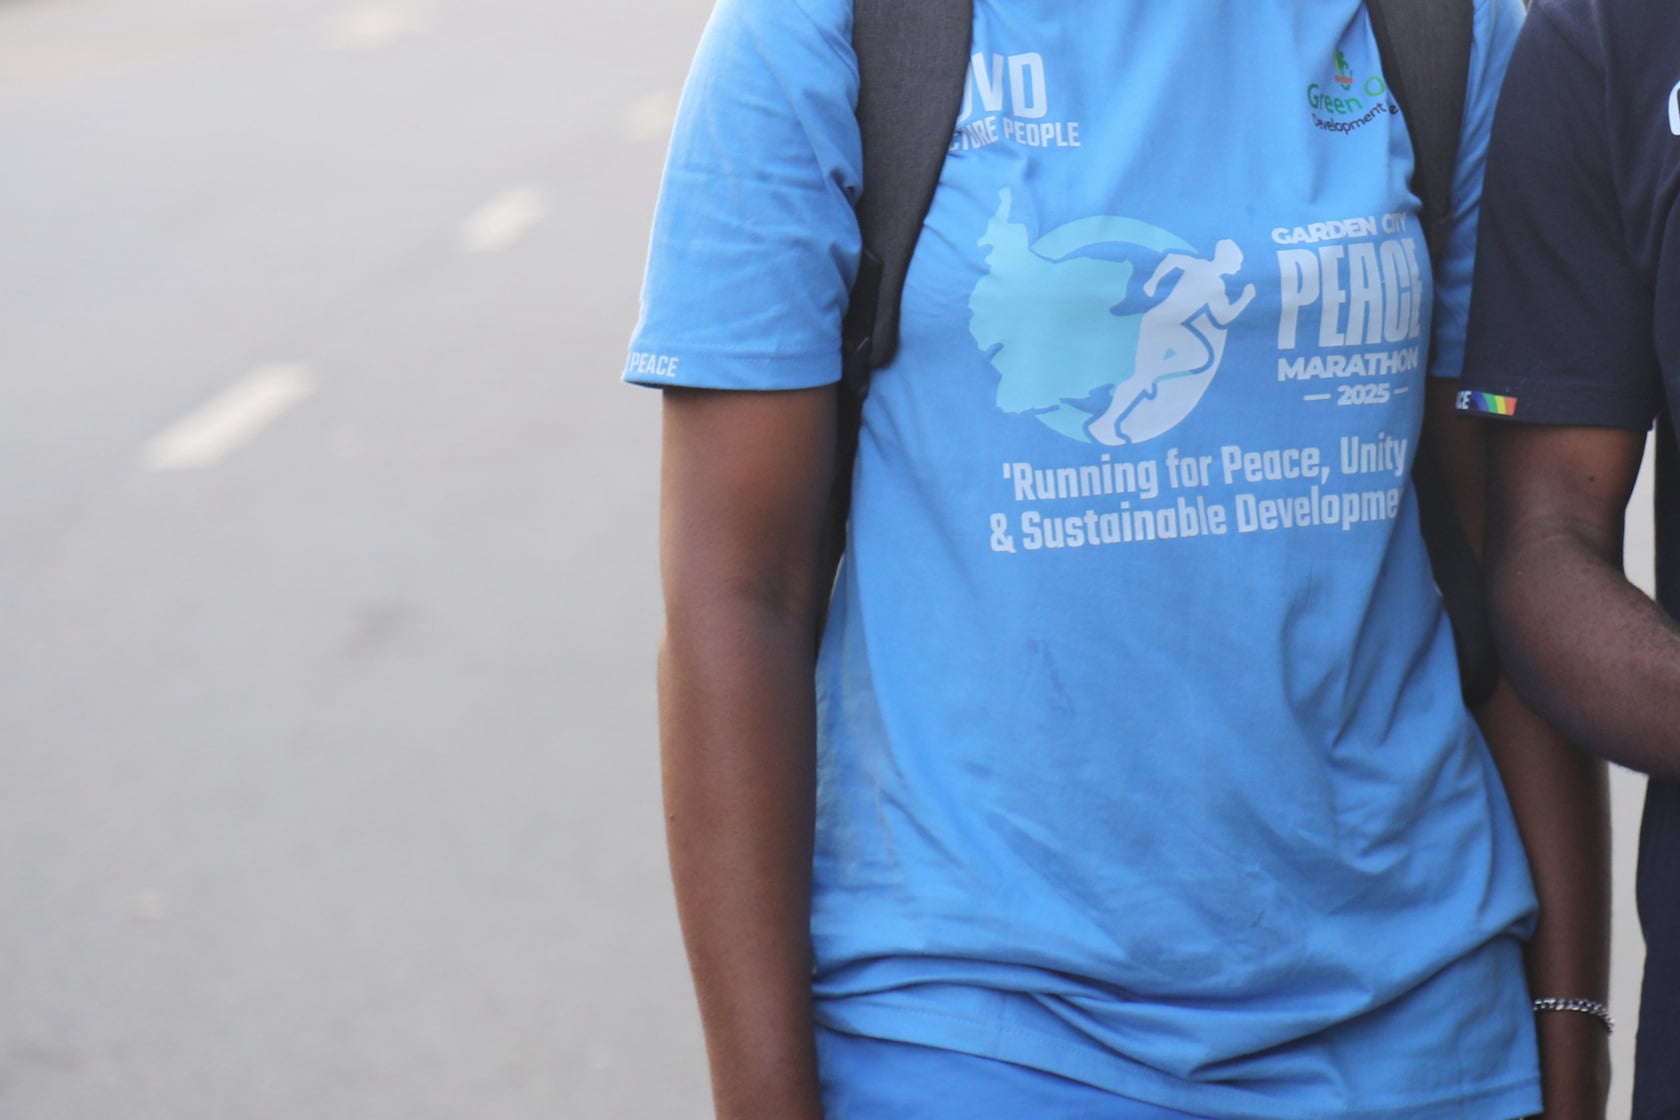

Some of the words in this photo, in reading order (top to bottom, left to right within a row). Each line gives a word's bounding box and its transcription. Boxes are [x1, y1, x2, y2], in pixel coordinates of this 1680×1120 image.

[1307, 83, 1363, 115] Green
[1002, 116, 1081, 148] PEOPLE
[1271, 216, 1377, 245] GARDEN
[1276, 237, 1423, 350] PEACE
[628, 351, 680, 378] PEACE
[1277, 345, 1419, 382] MARATHON
[1336, 383, 1391, 407] 2025
[1165, 447, 1212, 489] for
[1221, 444, 1331, 485] Peace,
[1340, 434, 1408, 477] Unity
[989, 512, 1017, 553] &
[1020, 494, 1228, 551] Sustainable
[1234, 484, 1402, 534] Developme
